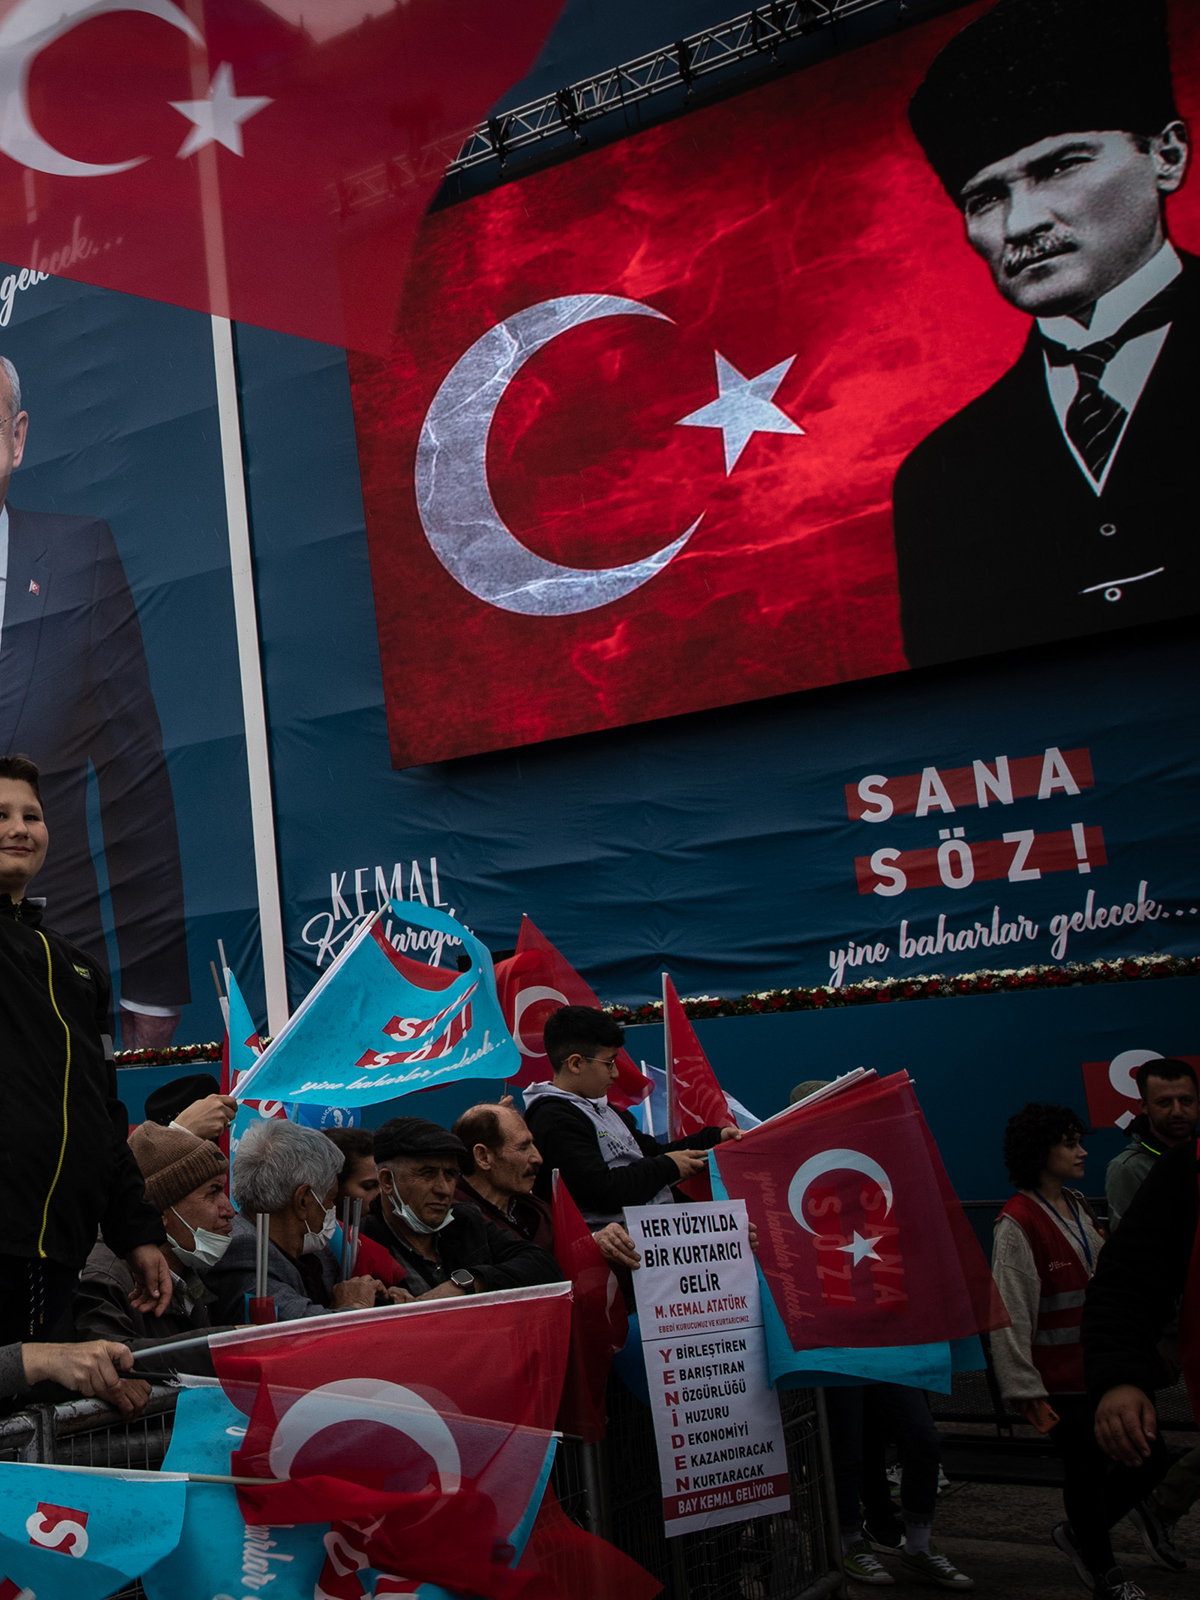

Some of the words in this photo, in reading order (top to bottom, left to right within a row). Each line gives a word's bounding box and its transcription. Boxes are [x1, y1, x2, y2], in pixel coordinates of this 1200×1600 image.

[858, 747, 1081, 823] SANA
[870, 822, 1091, 897] SÖZ!
[331, 857, 448, 920] KEMAL
[829, 941, 890, 987] yine
[899, 905, 1038, 959] baharlar
[1049, 880, 1198, 960] gelecek...
[641, 1219, 670, 1237] HER
[673, 1212, 738, 1235] YÜZYILDA
[645, 1244, 670, 1267] BİR
[673, 1242, 742, 1265] KURTARICI
[860, 1190, 908, 1304] SANA
[680, 1269, 721, 1294] GELİR
[655, 1305, 667, 1319] M.
[669, 1301, 705, 1317] KEMAL
[707, 1294, 748, 1313] ATATÜRK
[676, 1339, 747, 1360] BİRLEŞTİREN
[679, 1361, 745, 1380] BARIŞTIRAN
[682, 1379, 746, 1402] ÖZGÜRLÜĞÜ
[685, 1406, 729, 1424] HUZURU
[688, 1421, 748, 1445] EKONOMİYİ
[691, 1441, 774, 1467] KAZANDIRACAK
[693, 1464, 764, 1489] KURTARACAK
[678, 1497, 699, 1515] BAY
[700, 1490, 732, 1510] KEMAL
[735, 1482, 775, 1503] GELİYOR
